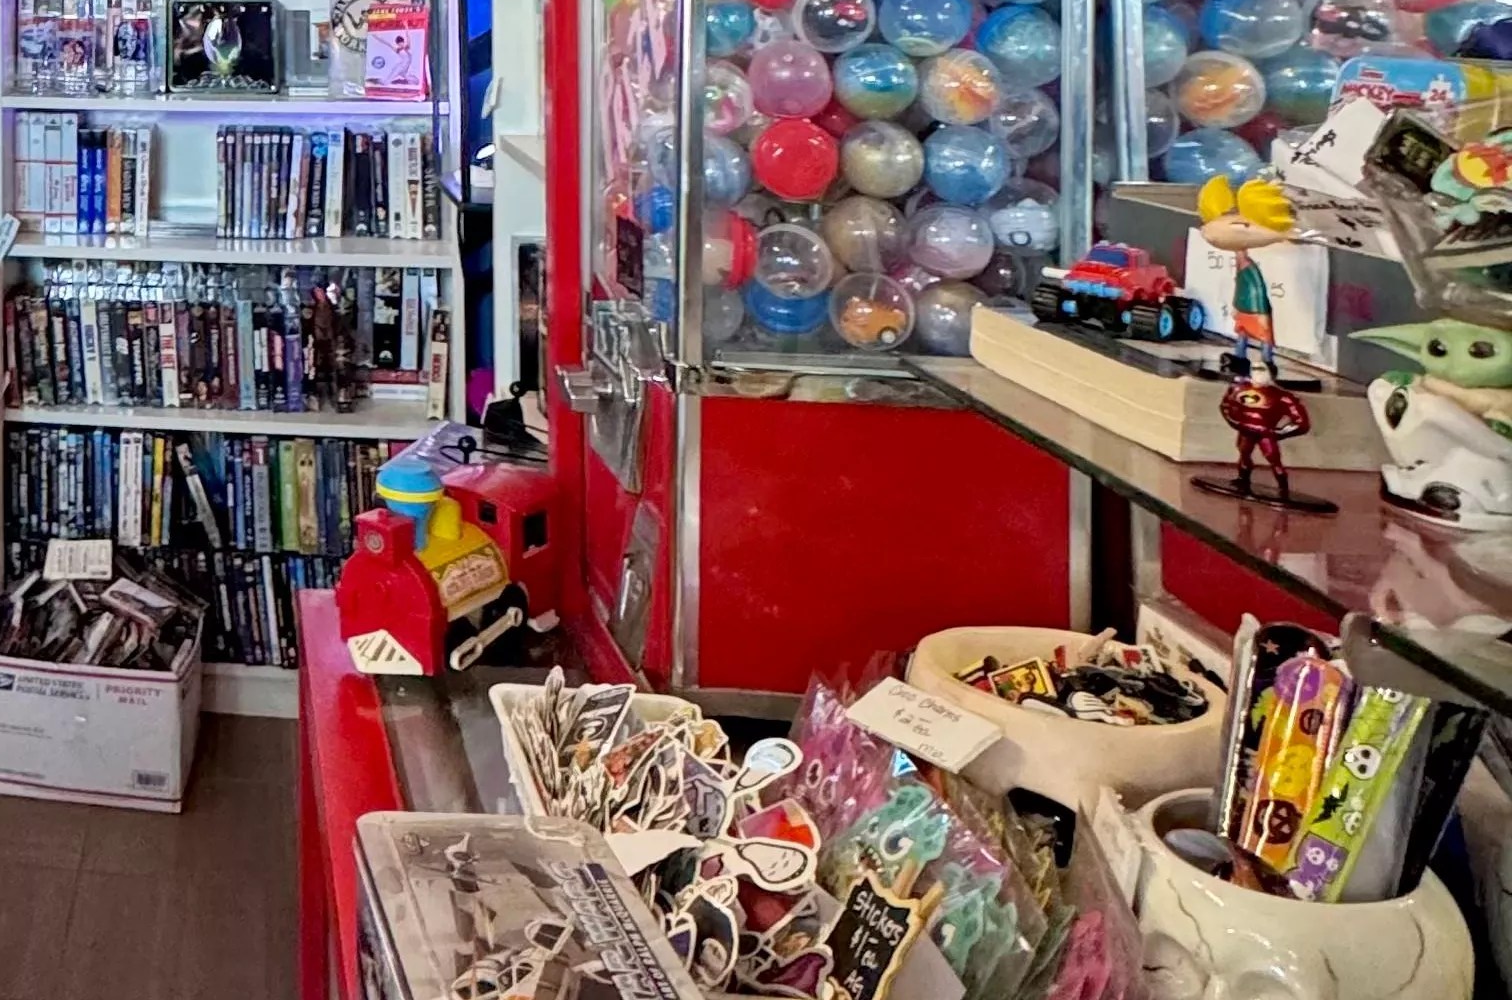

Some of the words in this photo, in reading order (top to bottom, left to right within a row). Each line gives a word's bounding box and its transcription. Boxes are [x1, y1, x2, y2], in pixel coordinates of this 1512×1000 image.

[1341, 83, 1396, 107] MICKEY
[1430, 88, 1448, 102] 24
[105, 684, 162, 697] PRIORITY
[117, 697, 148, 706] MAIL
[852, 889, 905, 948] Stickers
